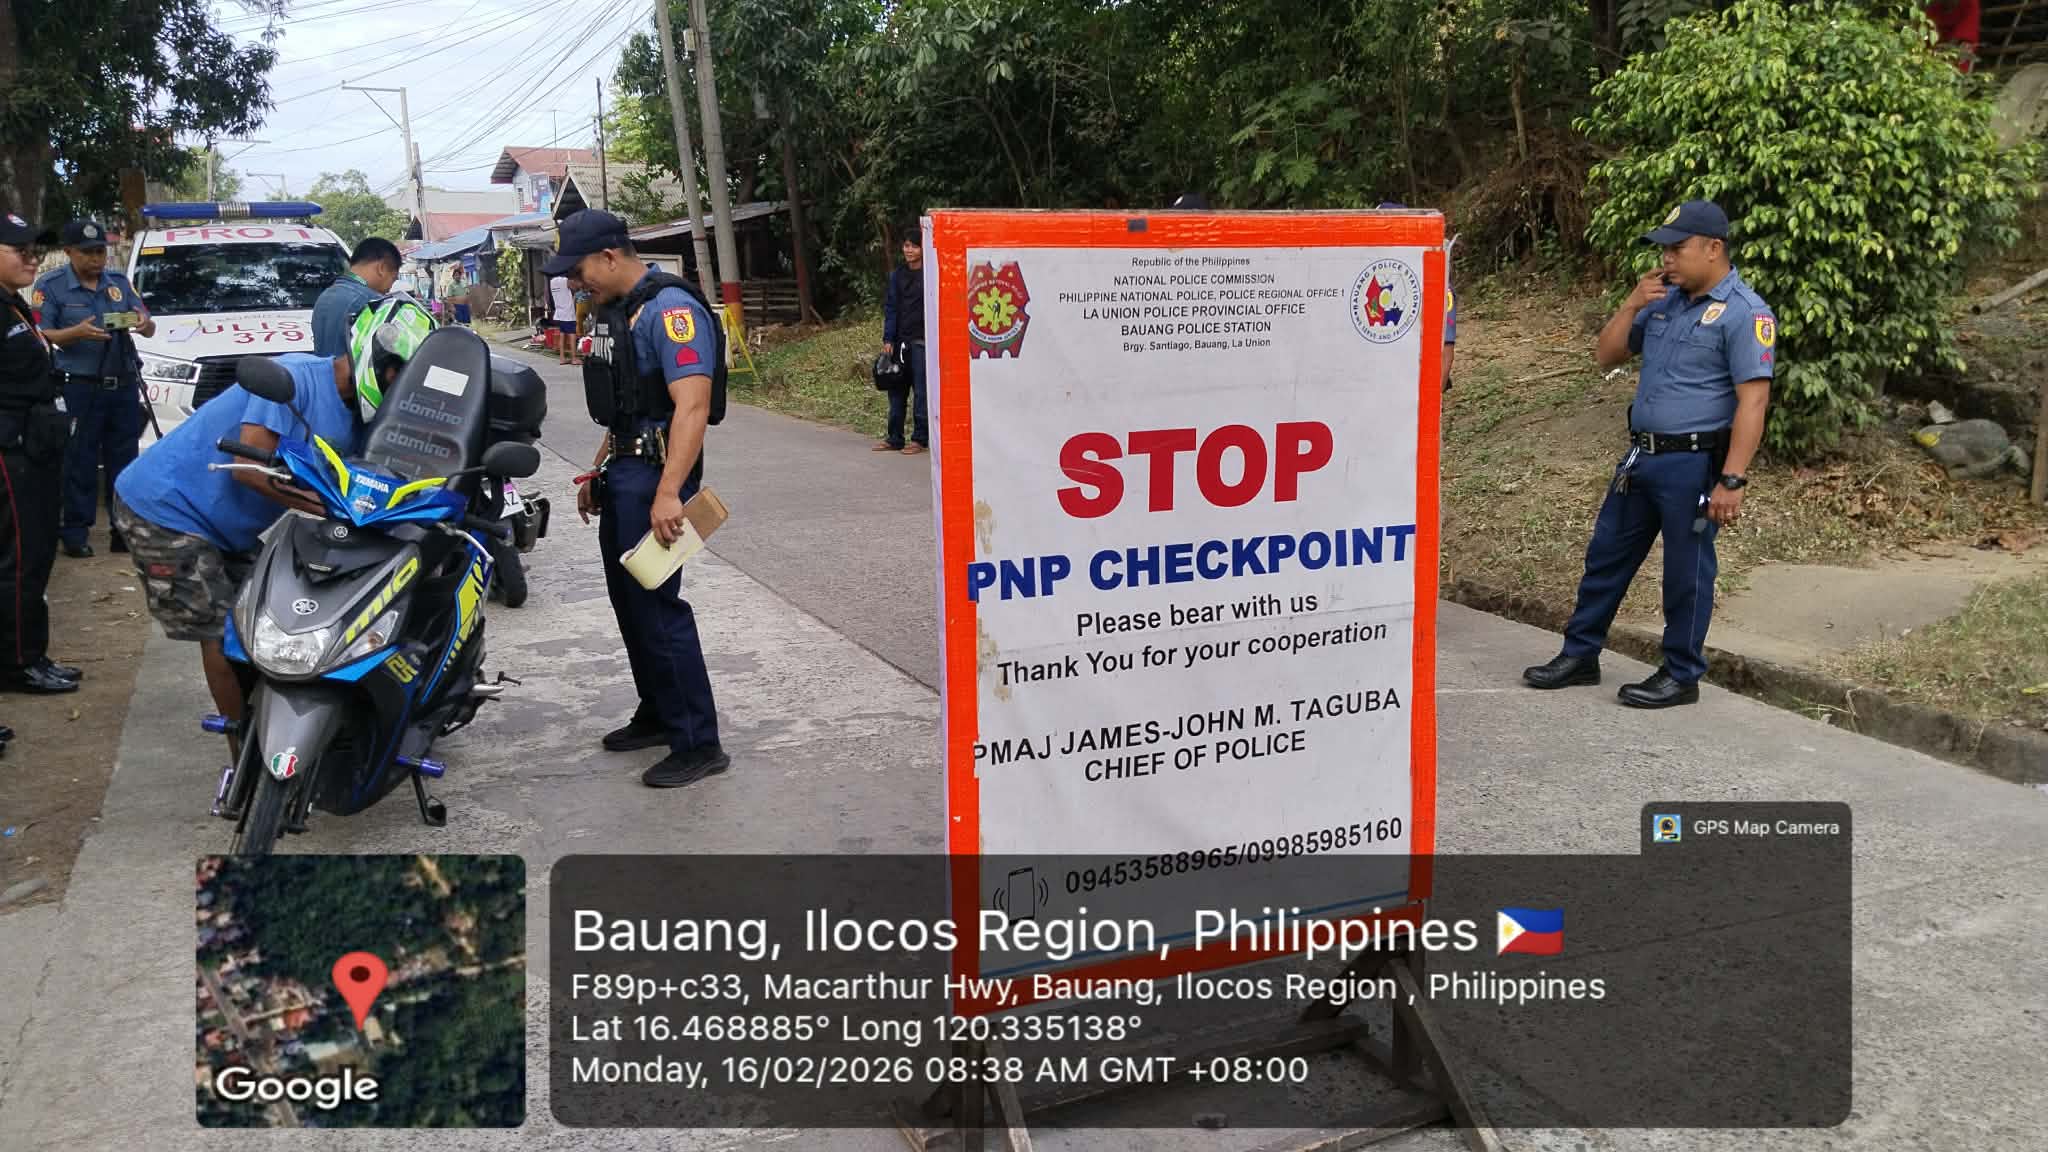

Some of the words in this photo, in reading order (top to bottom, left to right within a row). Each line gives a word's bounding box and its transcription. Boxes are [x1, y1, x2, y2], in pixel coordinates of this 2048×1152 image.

[166, 228, 274, 241] PRO
[288, 229, 311, 240] 1
[1132, 256, 1171, 267] Republic
[1175, 257, 1184, 266] of
[1186, 257, 1199, 266] the
[1202, 256, 1250, 268] Philippines
[1114, 276, 1166, 286] NATIONAL
[1170, 275, 1208, 285] POLICE
[1210, 274, 1275, 284] COMMISSION
[1372, 262, 1402, 272] POLICE
[1404, 270, 1418, 308] STATION
[1059, 292, 1117, 303] PHILIPPINE
[1120, 291, 1166, 301] NATIONAL
[1169, 290, 1216, 301] POLICE,
[1220, 290, 1255, 299] POLICE
[1258, 289, 1302, 299] REGIONAL
[1306, 288, 1338, 298] OFFICE
[1084, 308, 1099, 320] LA
[1102, 307, 1140, 319] UNION
[1144, 306, 1188, 318] POLICE
[1192, 304, 1262, 317] PROVINCIAL
[1265, 303, 1305, 315] OFFICE
[202, 322, 311, 334] ULIS
[1121, 324, 1174, 336] BAUANG
[1177, 322, 1220, 334] POLICE
[1224, 321, 1271, 333] STATION
[1123, 342, 1146, 353] Brgy.
[1150, 340, 1192, 352] Santiago,
[1194, 339, 1230, 350] Bauang,
[1232, 339, 1243, 348] La
[1245, 338, 1270, 347] Union
[1056, 421, 1334, 518] STOP
[355, 473, 389, 493] YAMAHA
[968, 555, 1070, 603] PNP
[1089, 524, 1416, 590] CHECKPOINT
[1077, 611, 1161, 636] Please
[1170, 604, 1224, 626] bear
[1232, 594, 1281, 619] with
[1290, 595, 1318, 612] us
[998, 655, 1079, 685] Thank
[1086, 651, 1133, 674] You
[1142, 645, 1177, 667] for
[1184, 640, 1240, 668] your
[1247, 622, 1386, 654] cooperation
[974, 736, 1051, 765] PMAJ
[1061, 708, 1244, 755] JAMES-JOHN
[1254, 704, 1281, 727] M.
[1290, 688, 1400, 721] TAGUBA
[1085, 752, 1165, 781] CHIEF
[1174, 745, 1207, 770] OF
[1216, 730, 1305, 763] POLICE
[1066, 816, 1402, 894] 09453588965/09985985160
